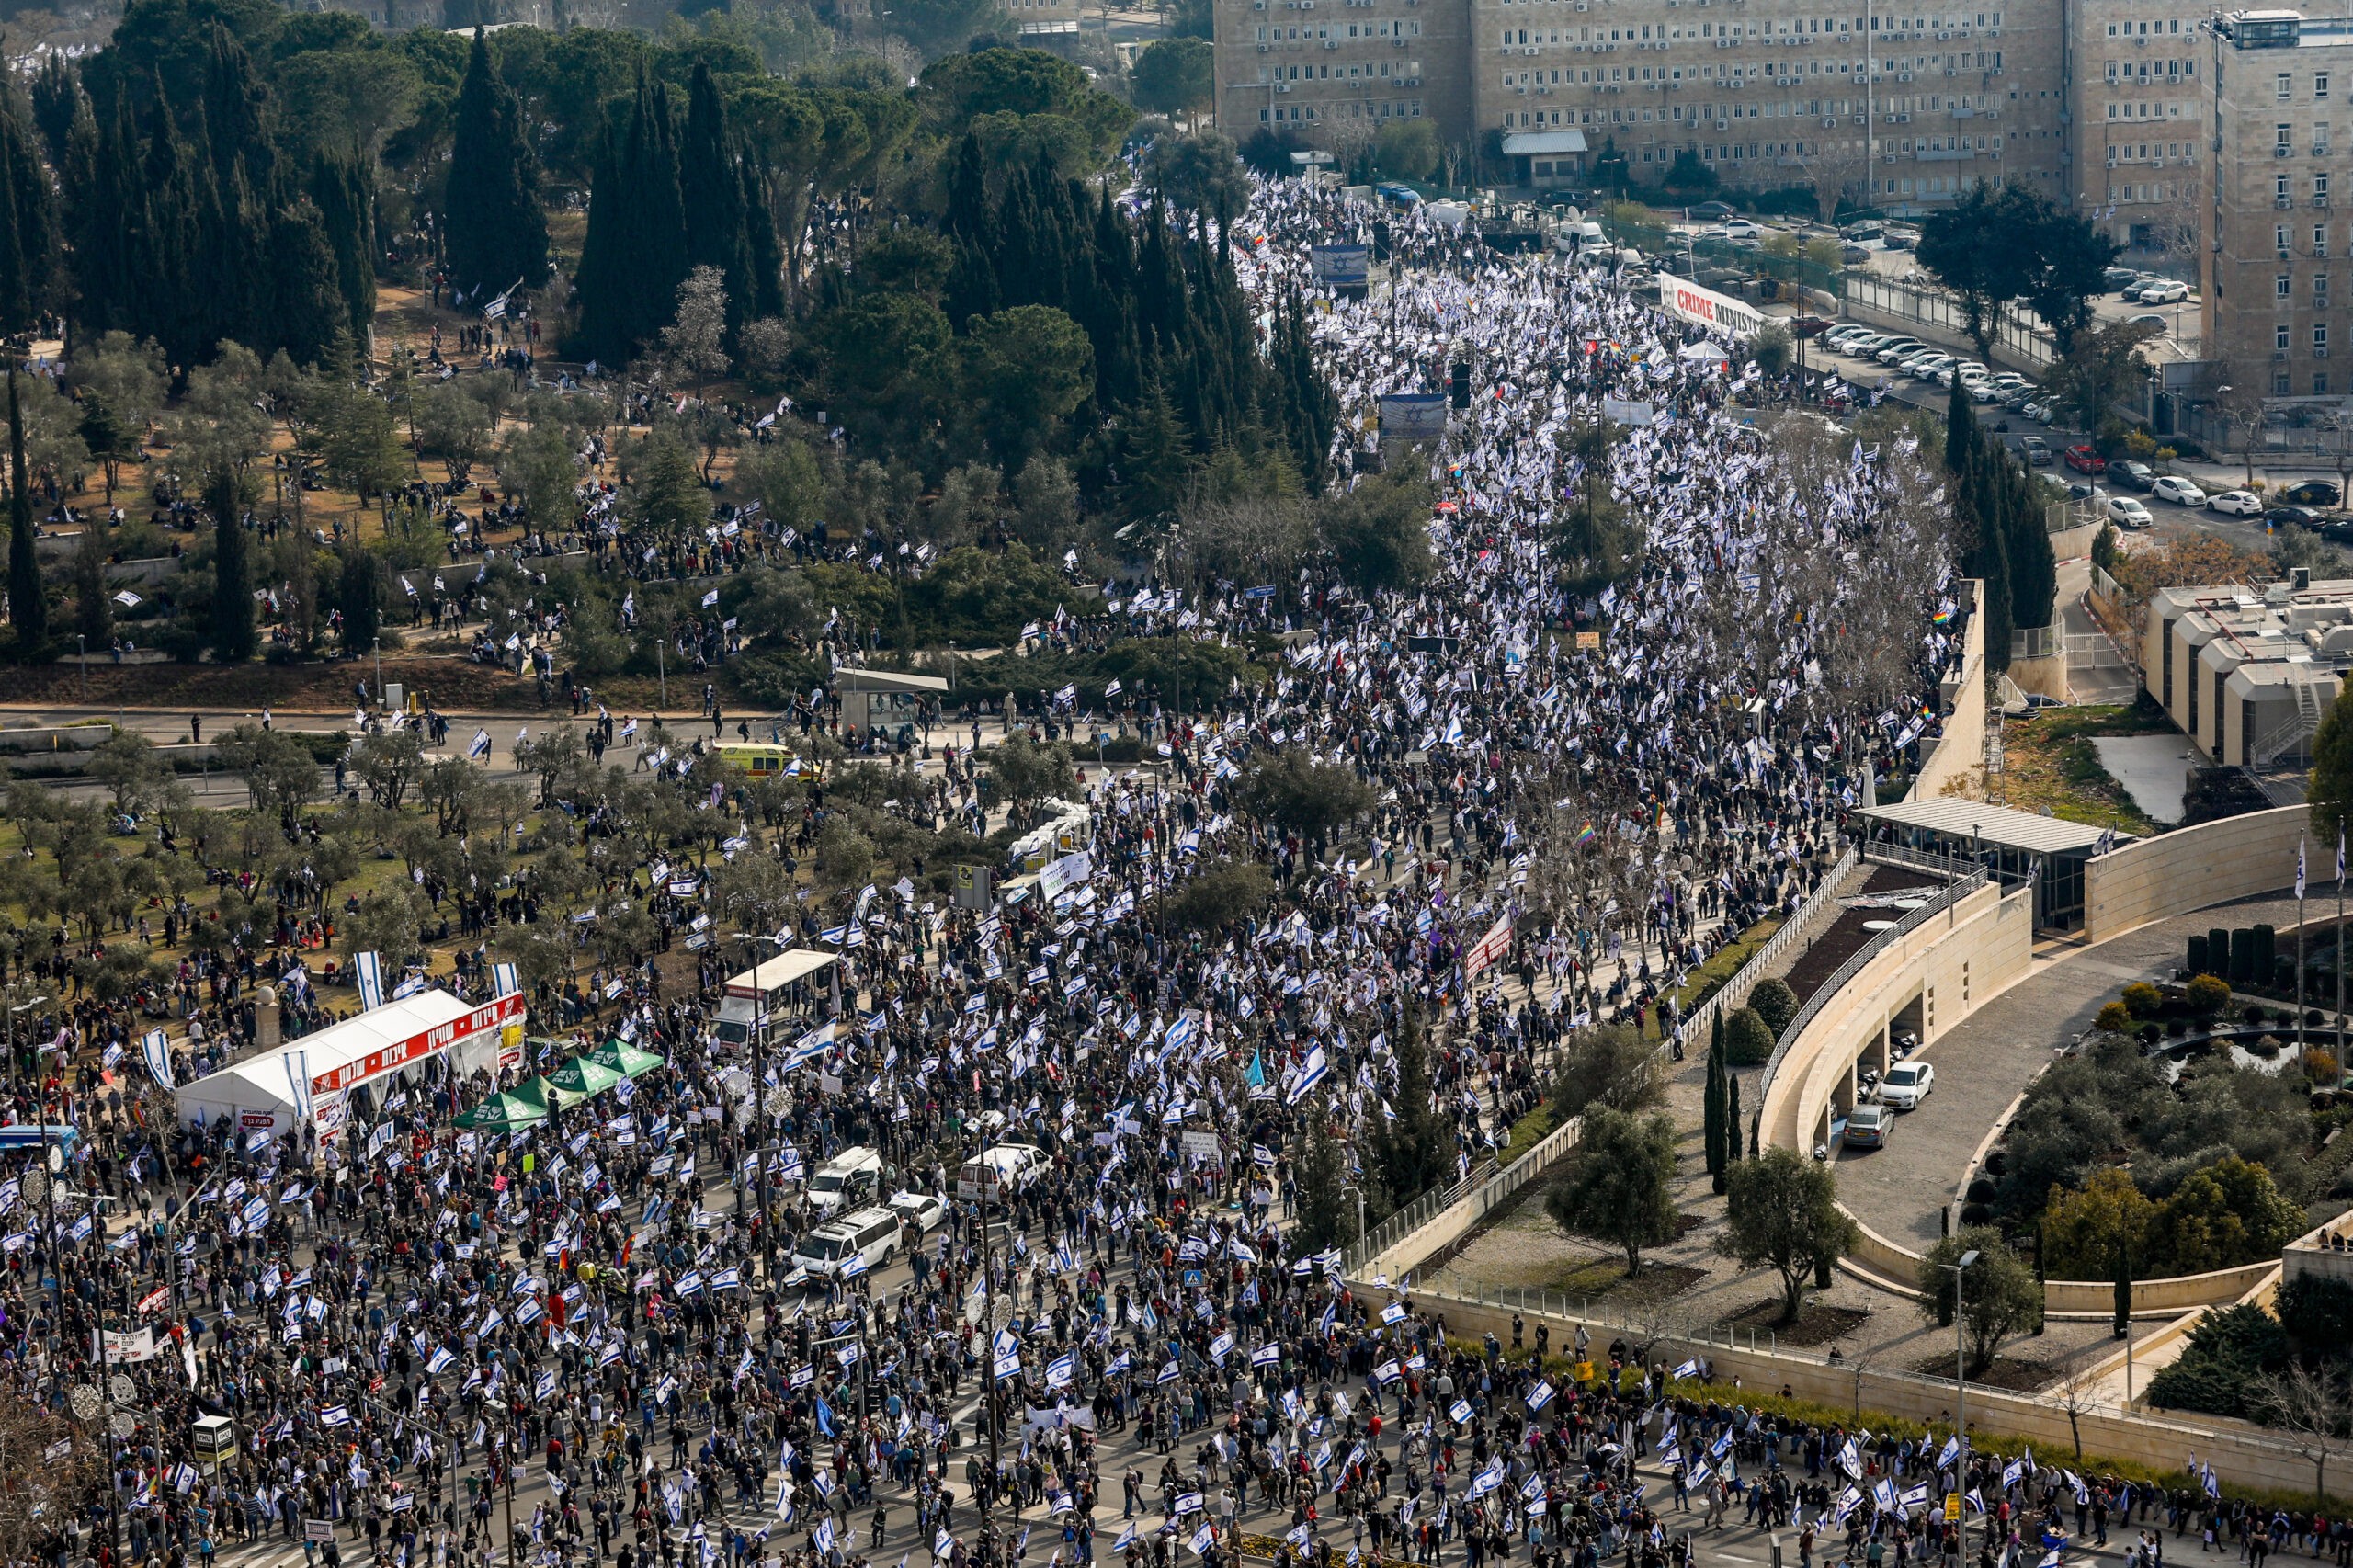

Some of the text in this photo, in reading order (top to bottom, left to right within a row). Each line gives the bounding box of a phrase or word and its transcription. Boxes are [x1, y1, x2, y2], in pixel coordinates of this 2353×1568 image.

[1677, 289, 1713, 320] CRIME
[339, 1006, 498, 1088] חירות שוויון איכות שלטון
